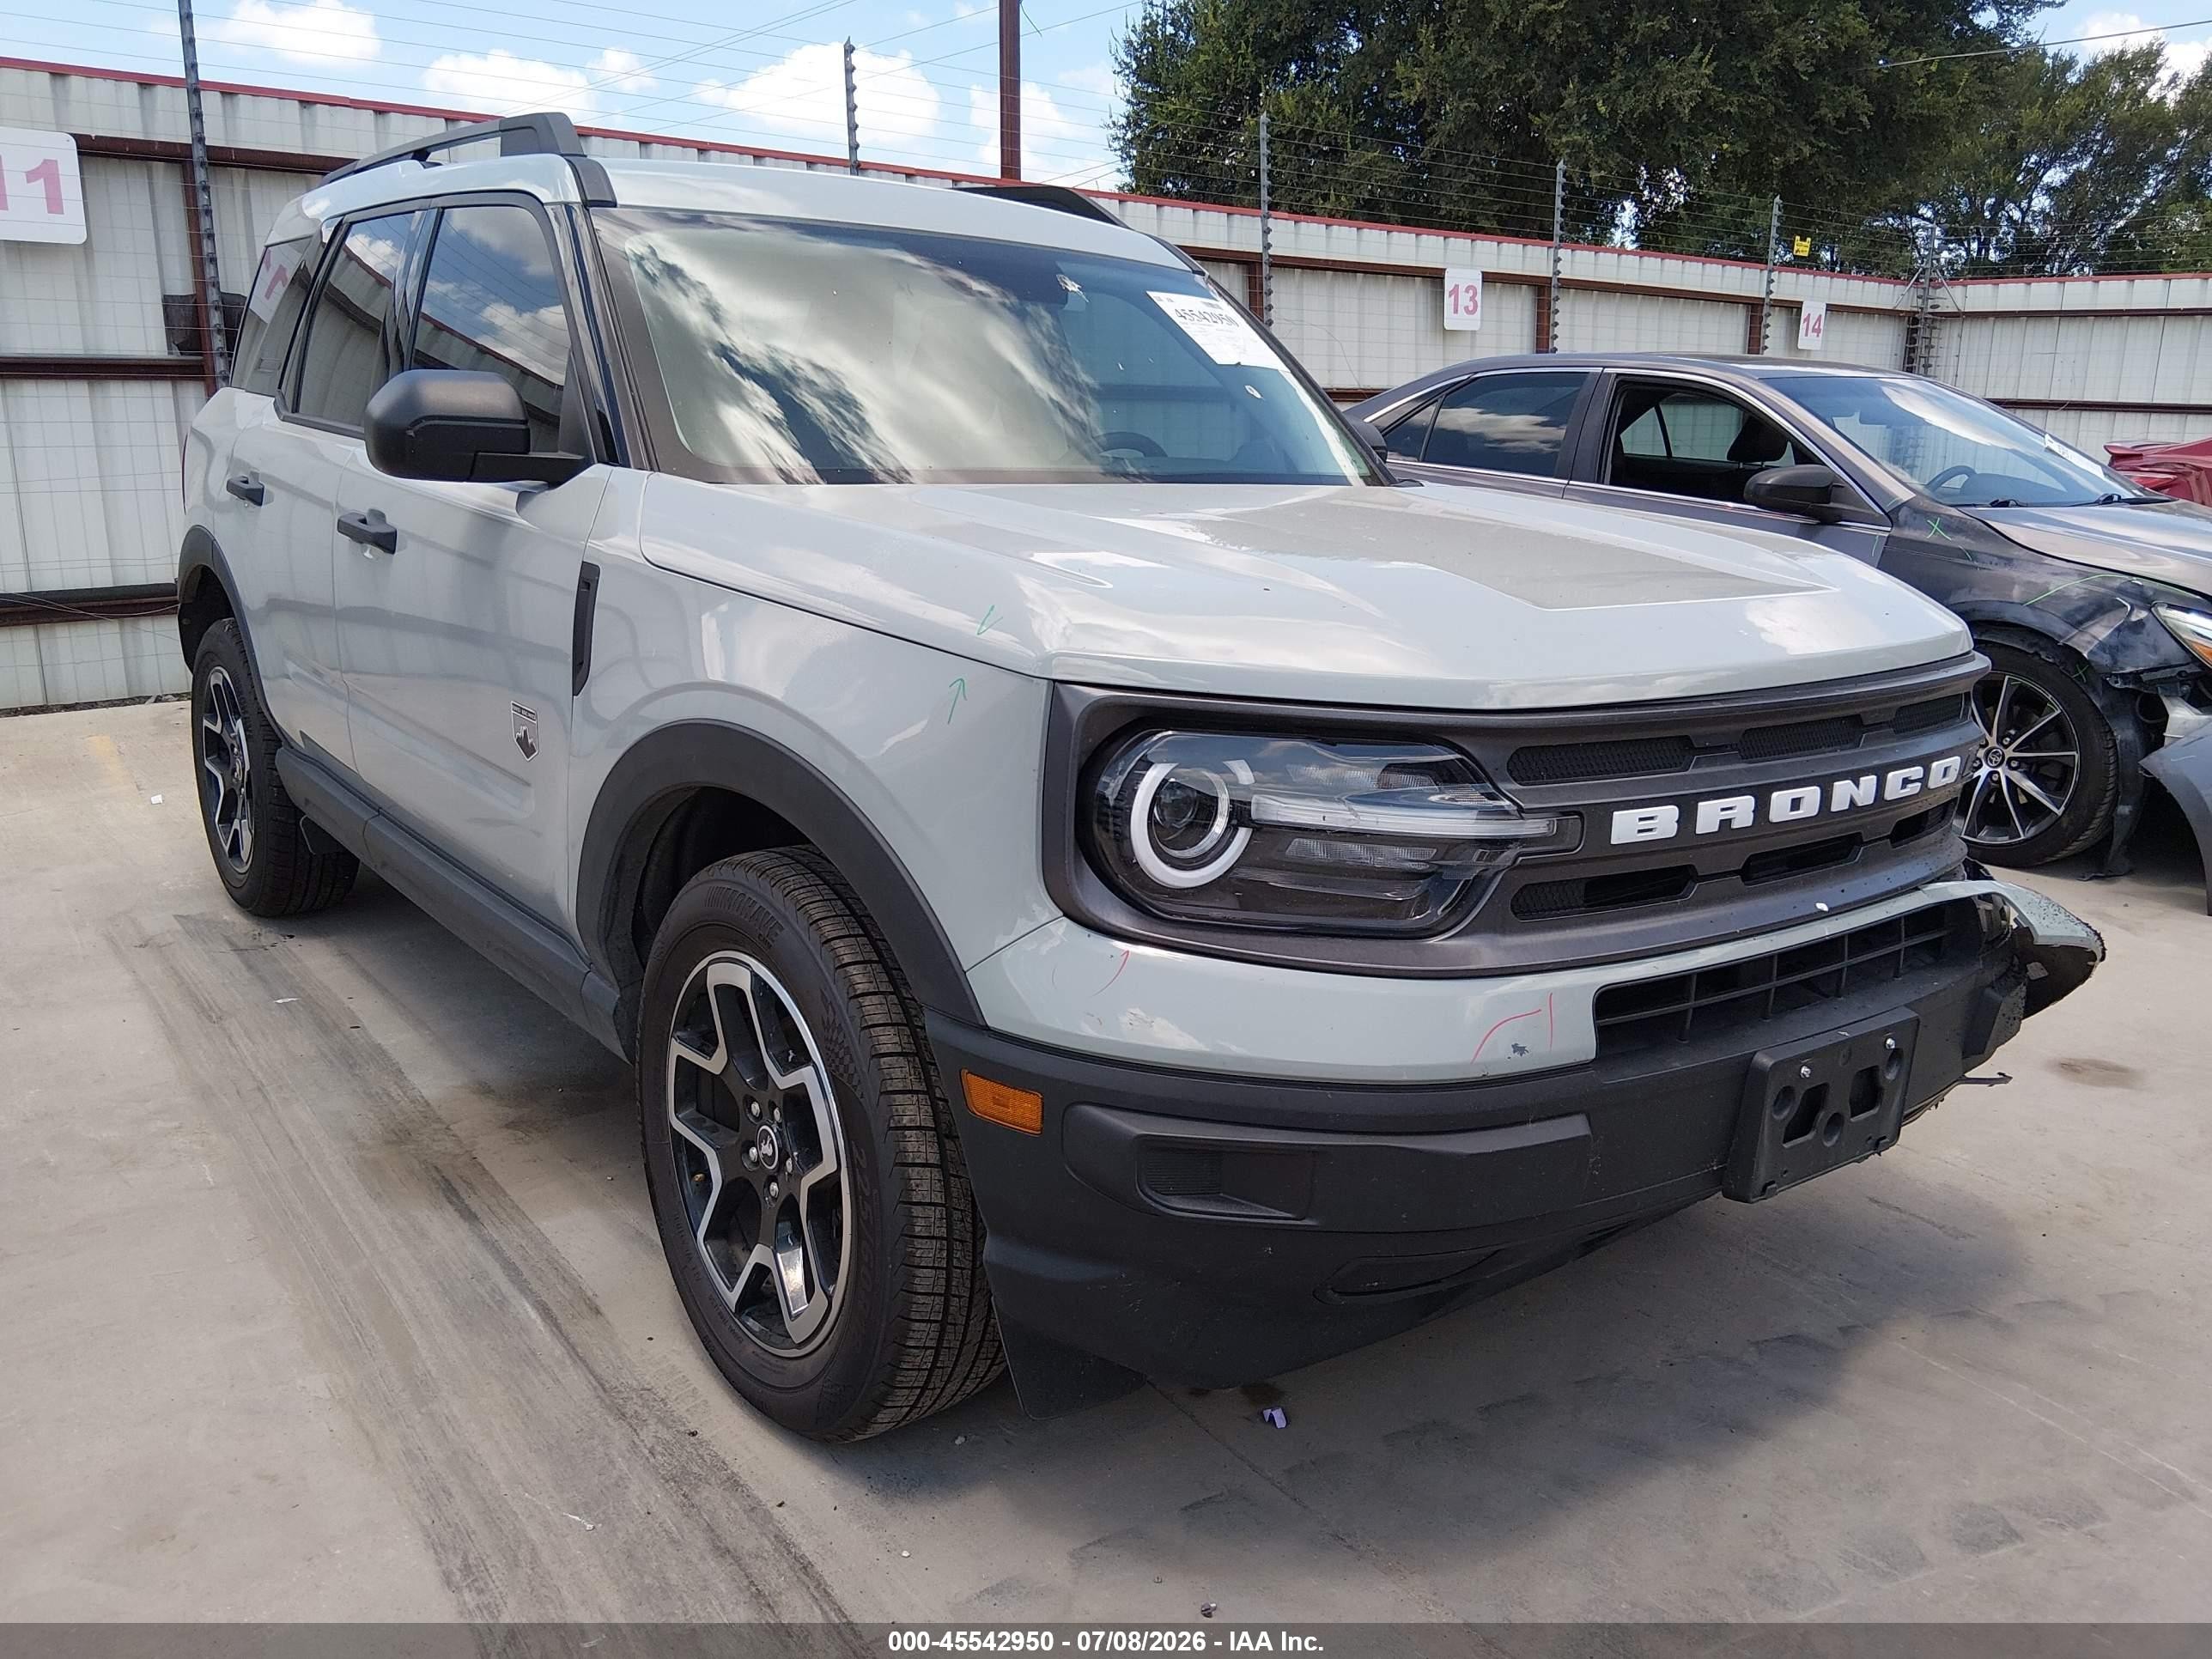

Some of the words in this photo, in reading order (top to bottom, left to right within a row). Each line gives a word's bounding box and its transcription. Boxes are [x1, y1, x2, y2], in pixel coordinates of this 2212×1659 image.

[1448, 283, 1479, 316] 13
[1802, 313, 1822, 337] 14
[1610, 756, 1961, 844] BRONCO
